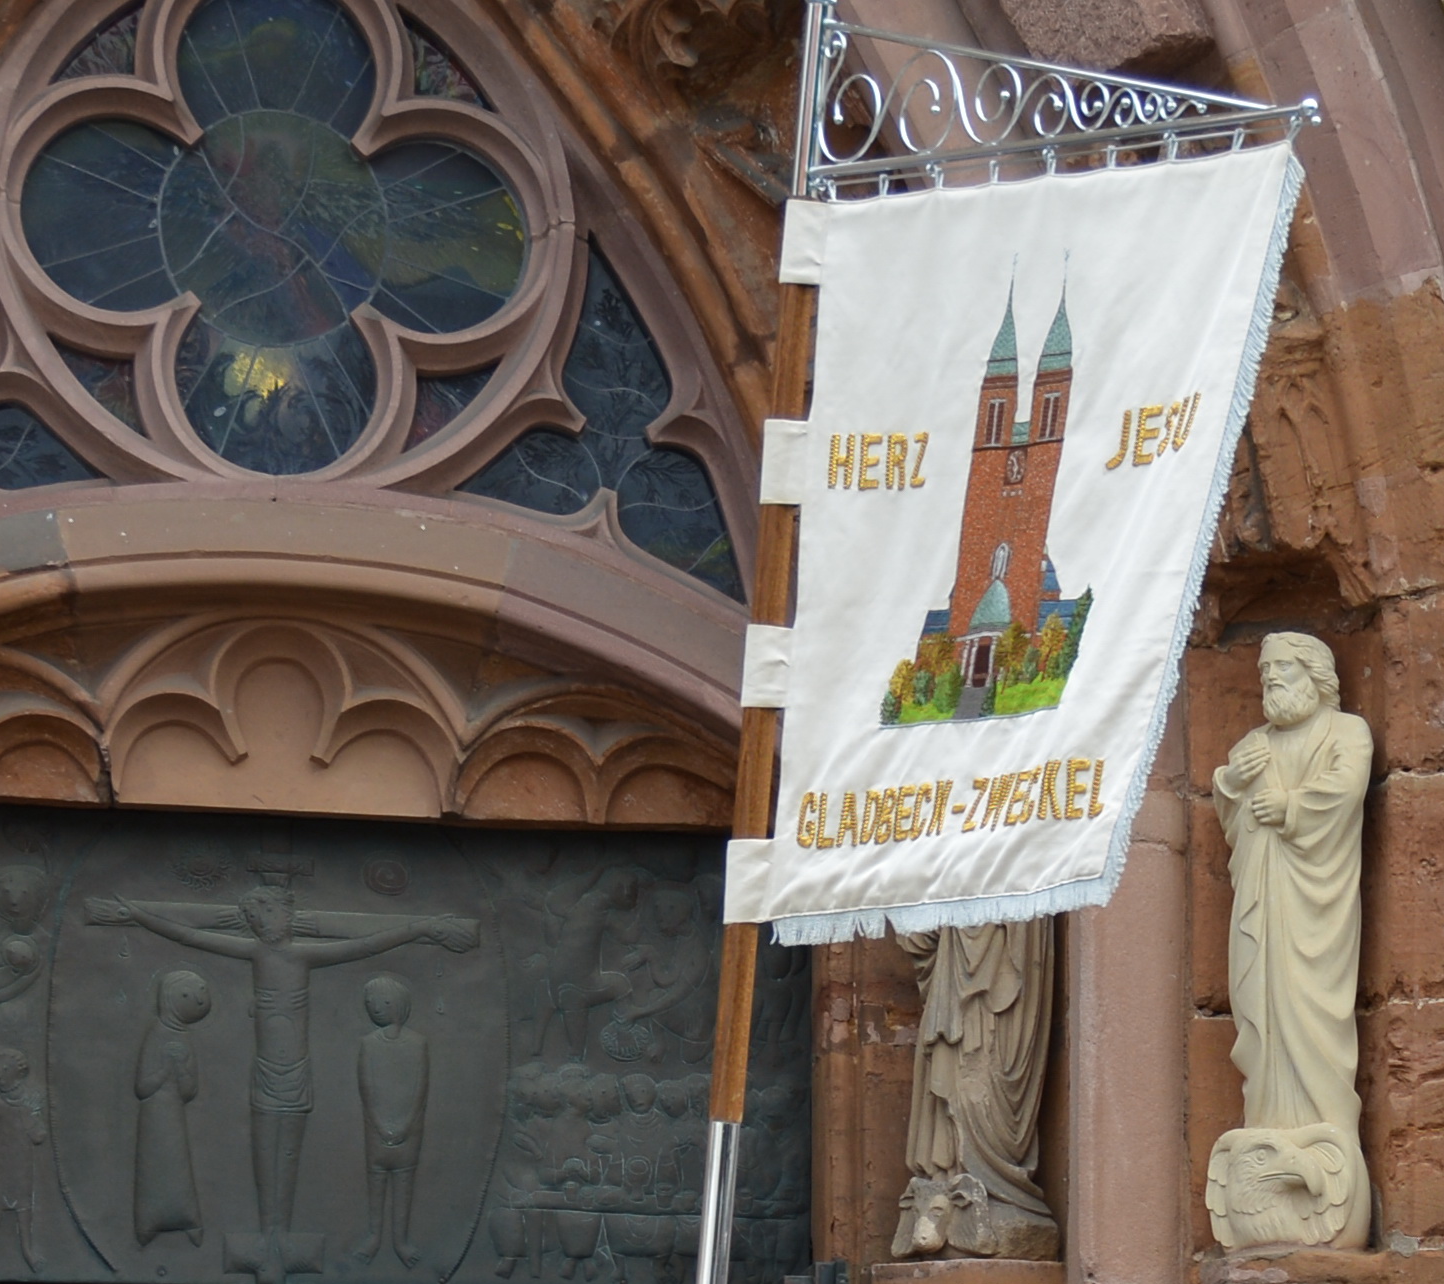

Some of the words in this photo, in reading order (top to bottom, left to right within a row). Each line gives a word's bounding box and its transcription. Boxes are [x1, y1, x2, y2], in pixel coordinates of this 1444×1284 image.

[827, 432, 930, 491] HERZ
[1106, 392, 1201, 470] JESU
[796, 757, 1105, 850] GLADBECK-ZWECKEL
